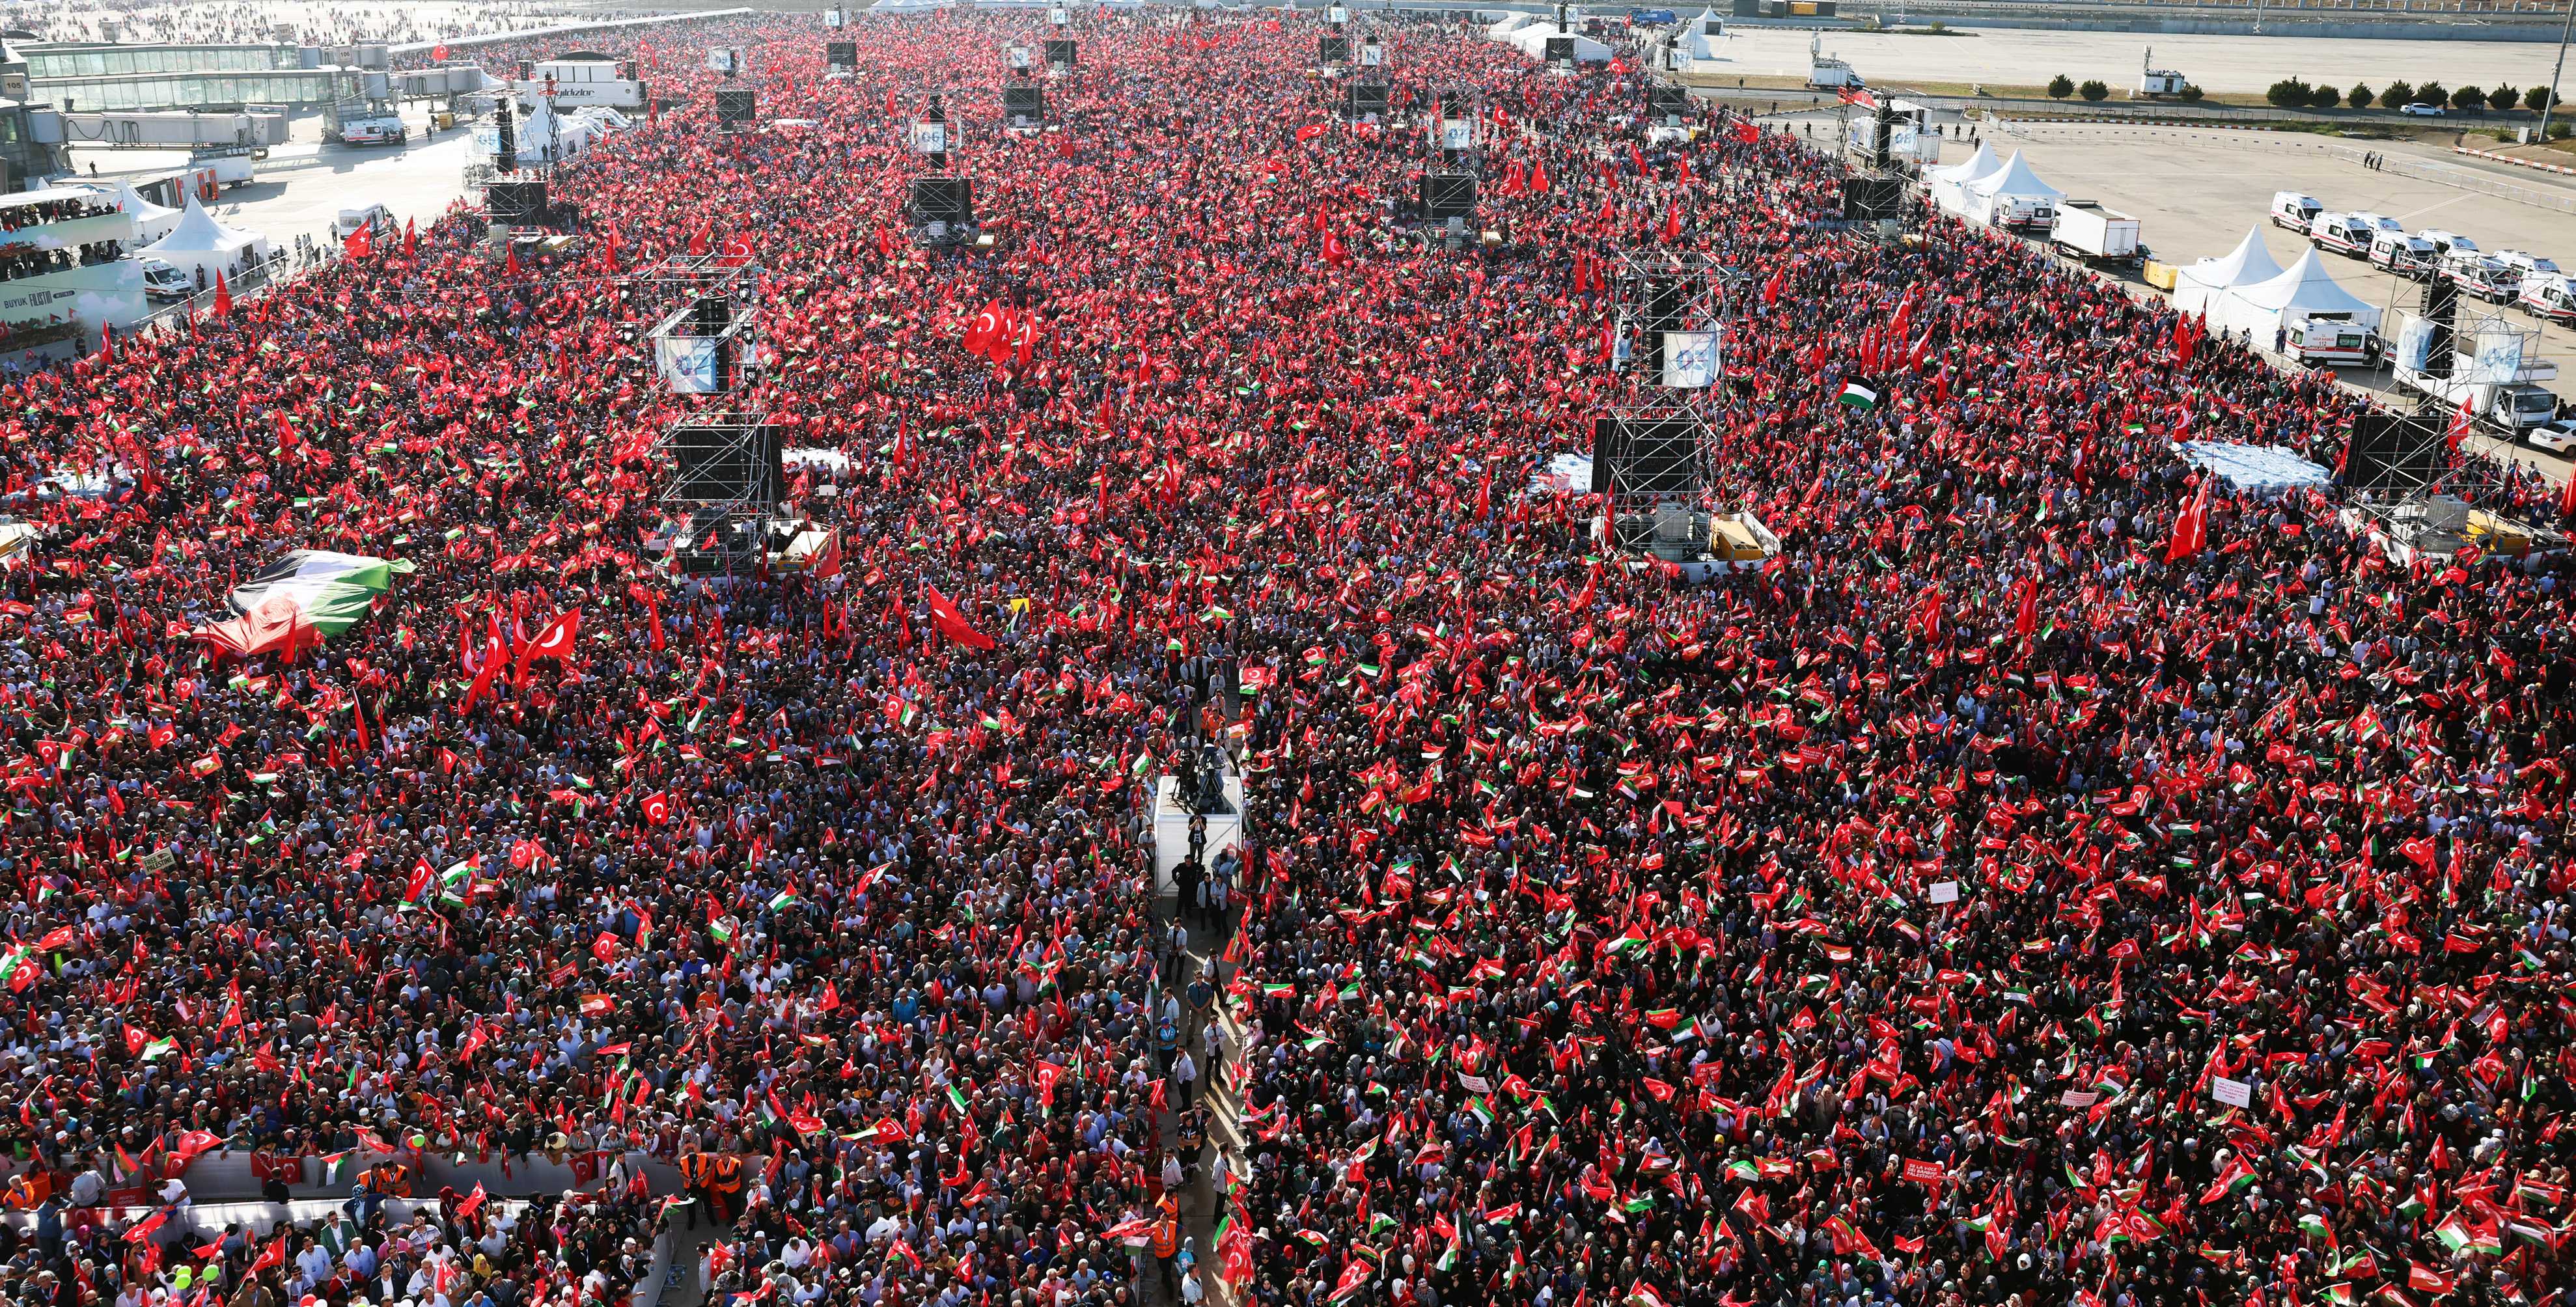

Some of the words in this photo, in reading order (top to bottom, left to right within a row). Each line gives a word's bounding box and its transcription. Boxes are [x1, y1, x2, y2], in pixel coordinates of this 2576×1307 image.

[676, 353, 710, 376] 02
[1676, 350, 1709, 371] 03
[144, 856, 157, 866] FREE
[146, 855, 173, 872] PALESTINE
